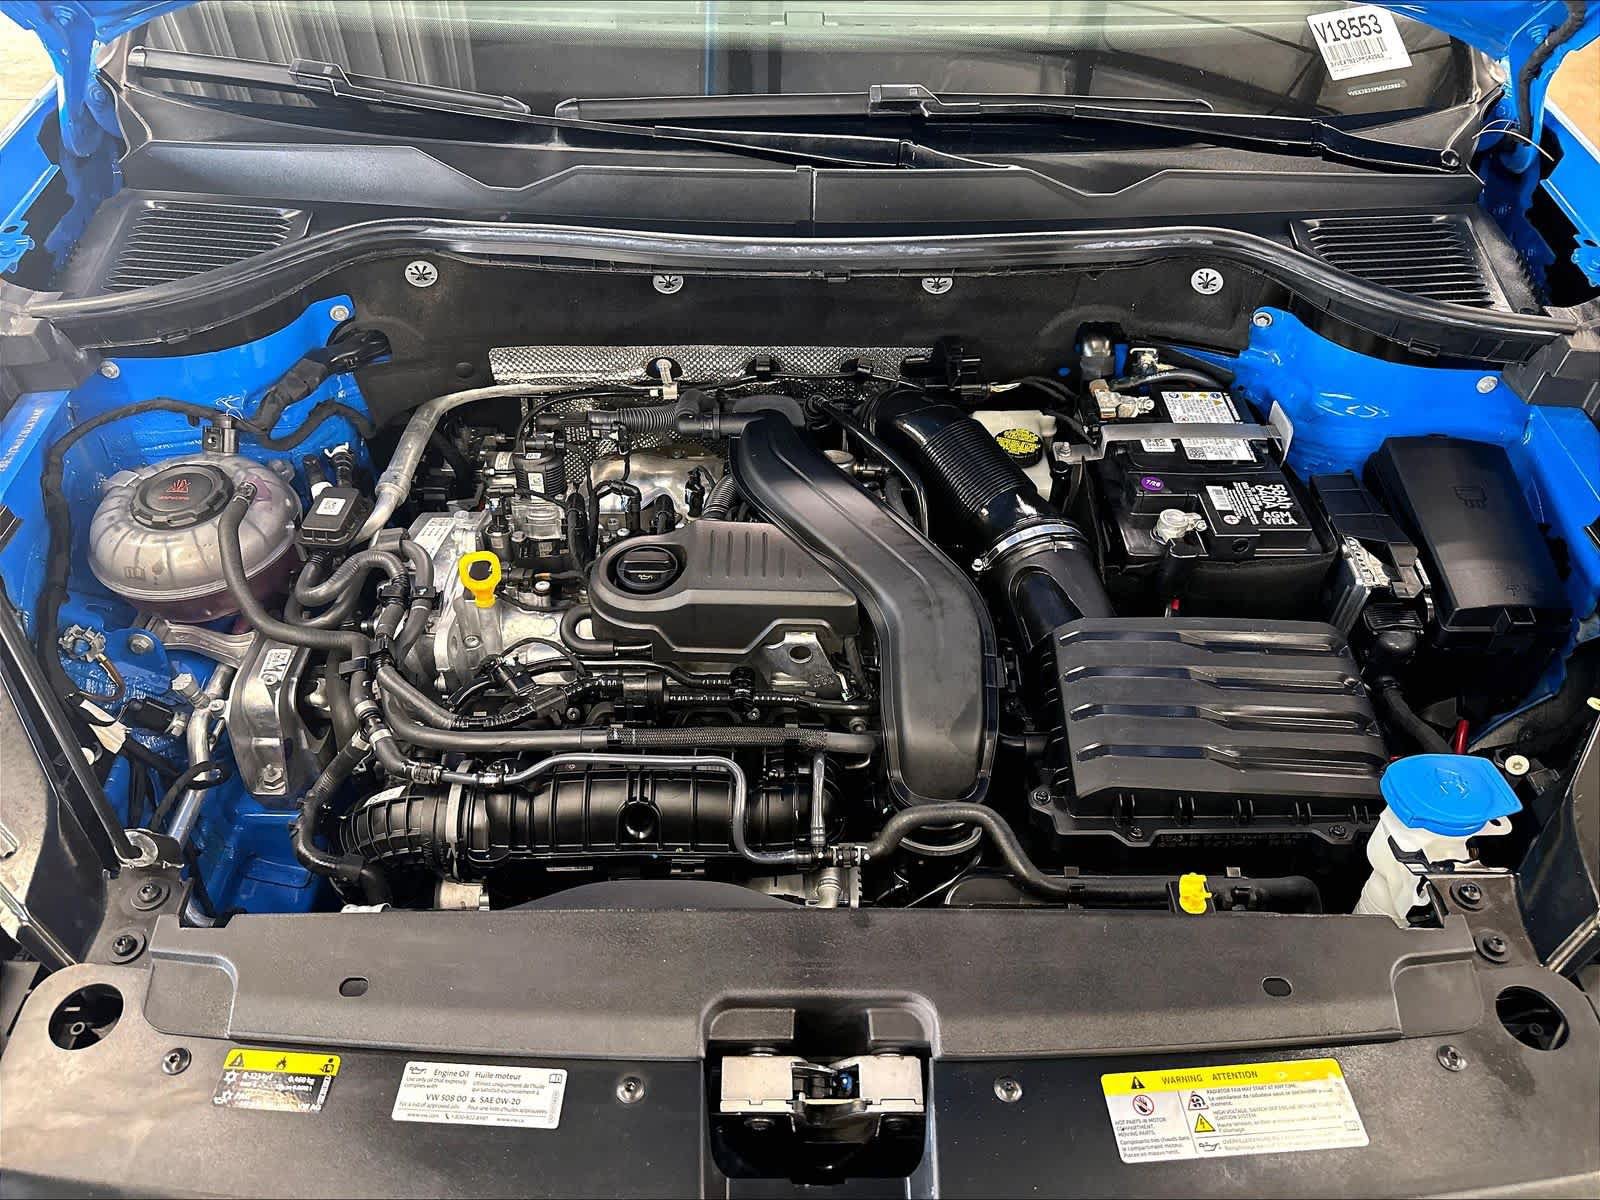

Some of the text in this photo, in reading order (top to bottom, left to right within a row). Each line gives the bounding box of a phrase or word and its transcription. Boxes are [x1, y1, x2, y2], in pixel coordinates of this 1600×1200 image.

[1314, 14, 1383, 44] V18553
[433, 1068, 470, 1079] Engine Oil
[475, 1071, 521, 1080] Huile moteur
[1212, 1071, 1258, 1081] ATTENTION
[1161, 1074, 1203, 1085] WARNING
[426, 1093, 440, 1101] VW
[441, 1094, 455, 1102] 508
[479, 1095, 494, 1104] SAE
[495, 1097, 521, 1105] 0W-20
